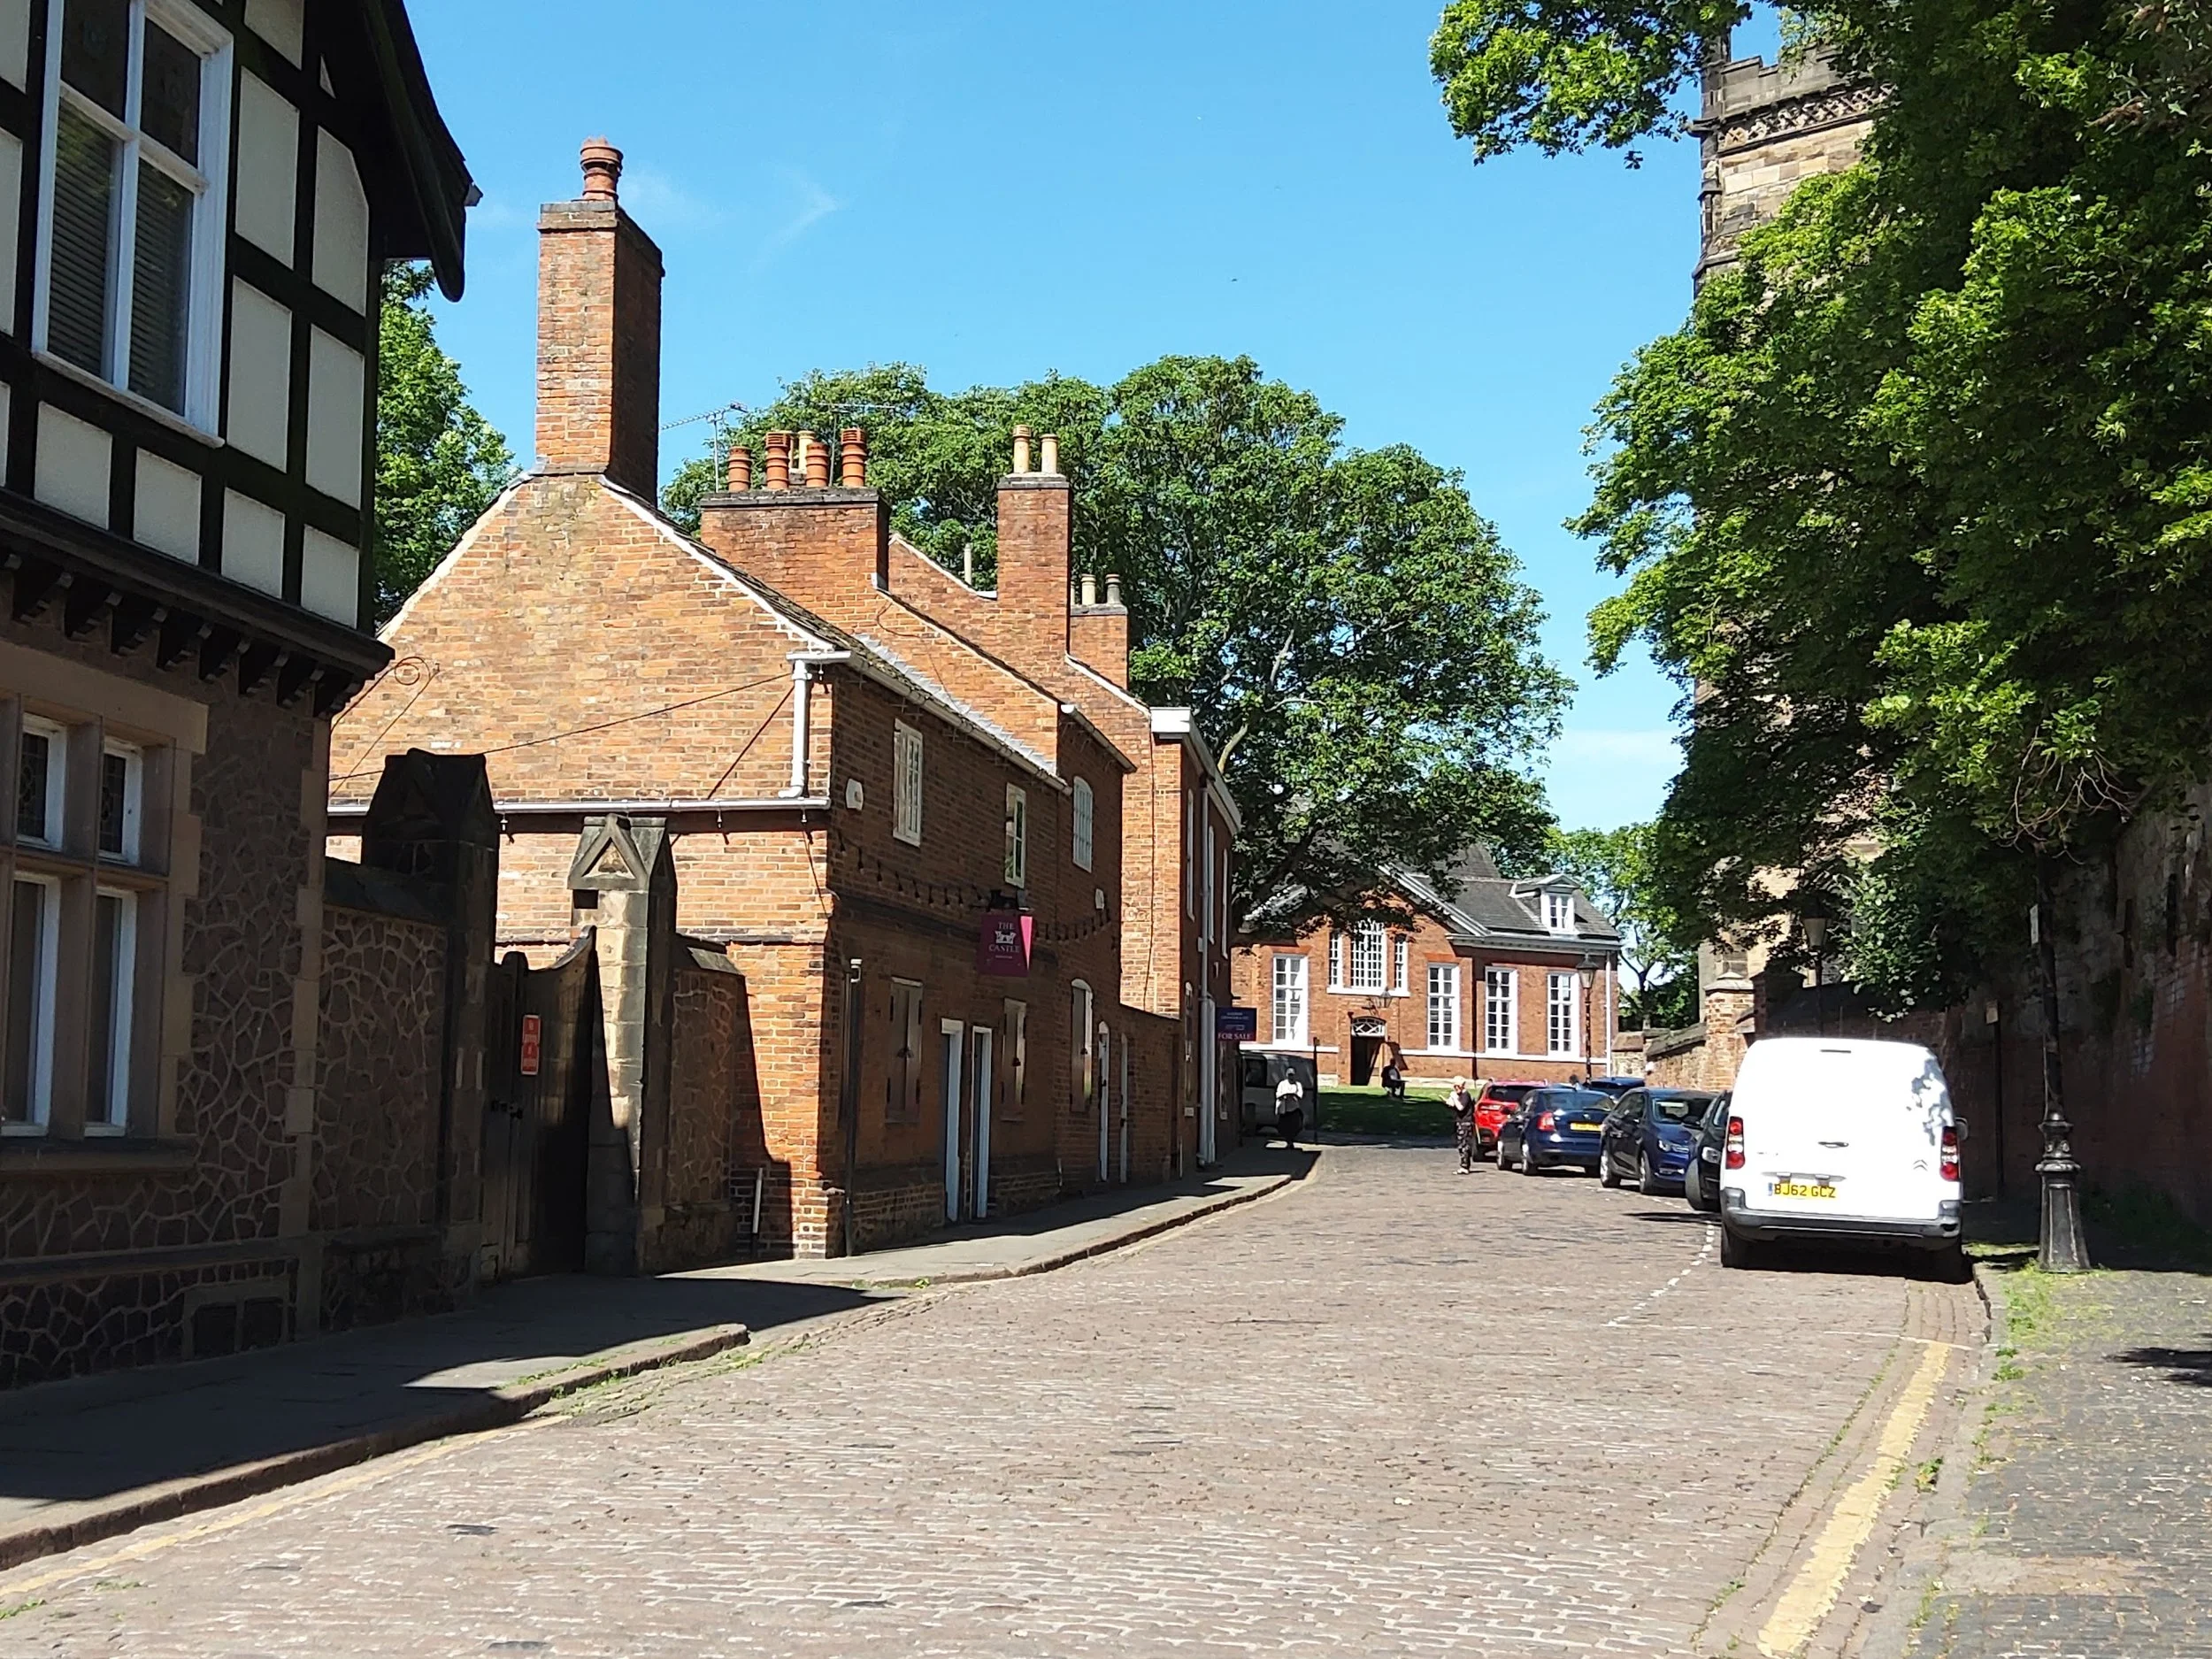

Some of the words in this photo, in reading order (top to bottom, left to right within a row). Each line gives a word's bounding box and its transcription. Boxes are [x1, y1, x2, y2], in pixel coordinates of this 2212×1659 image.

[998, 921, 1015, 930] THE
[988, 943, 1020, 953] CASTLE
[1774, 1183, 1808, 1196] BJ62
[1811, 1186, 1836, 1198] GCZ
